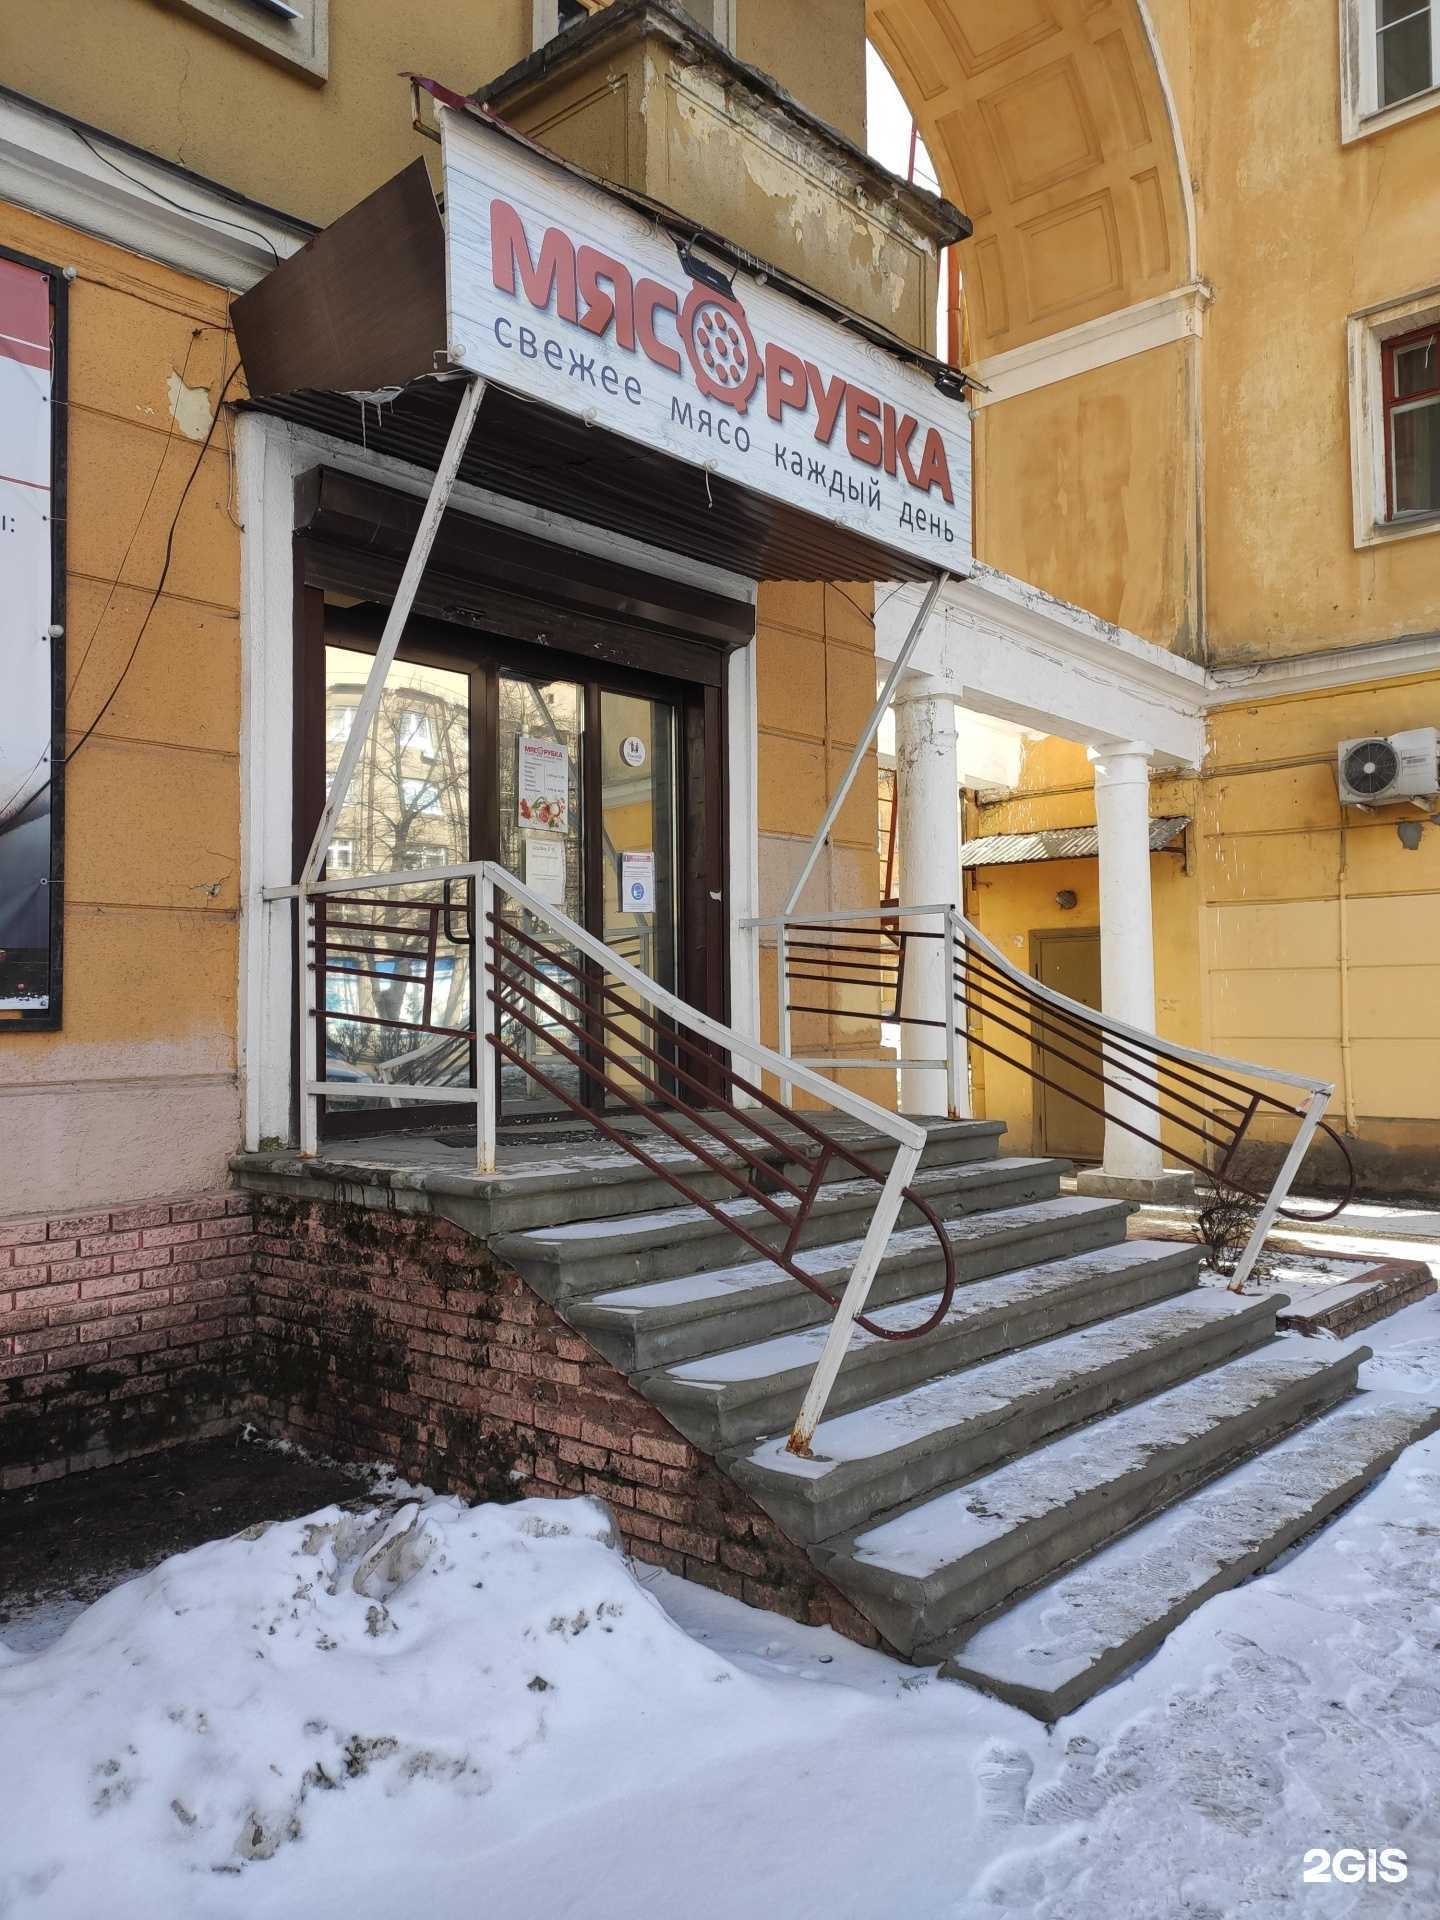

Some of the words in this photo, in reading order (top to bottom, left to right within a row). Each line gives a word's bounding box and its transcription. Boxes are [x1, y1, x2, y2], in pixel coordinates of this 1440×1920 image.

[489, 199, 955, 504] МЯСОРУБКА
[494, 316, 642, 405] свежее
[670, 397, 751, 453] мясо
[774, 442, 881, 511] каждый
[898, 497, 955, 543] день
